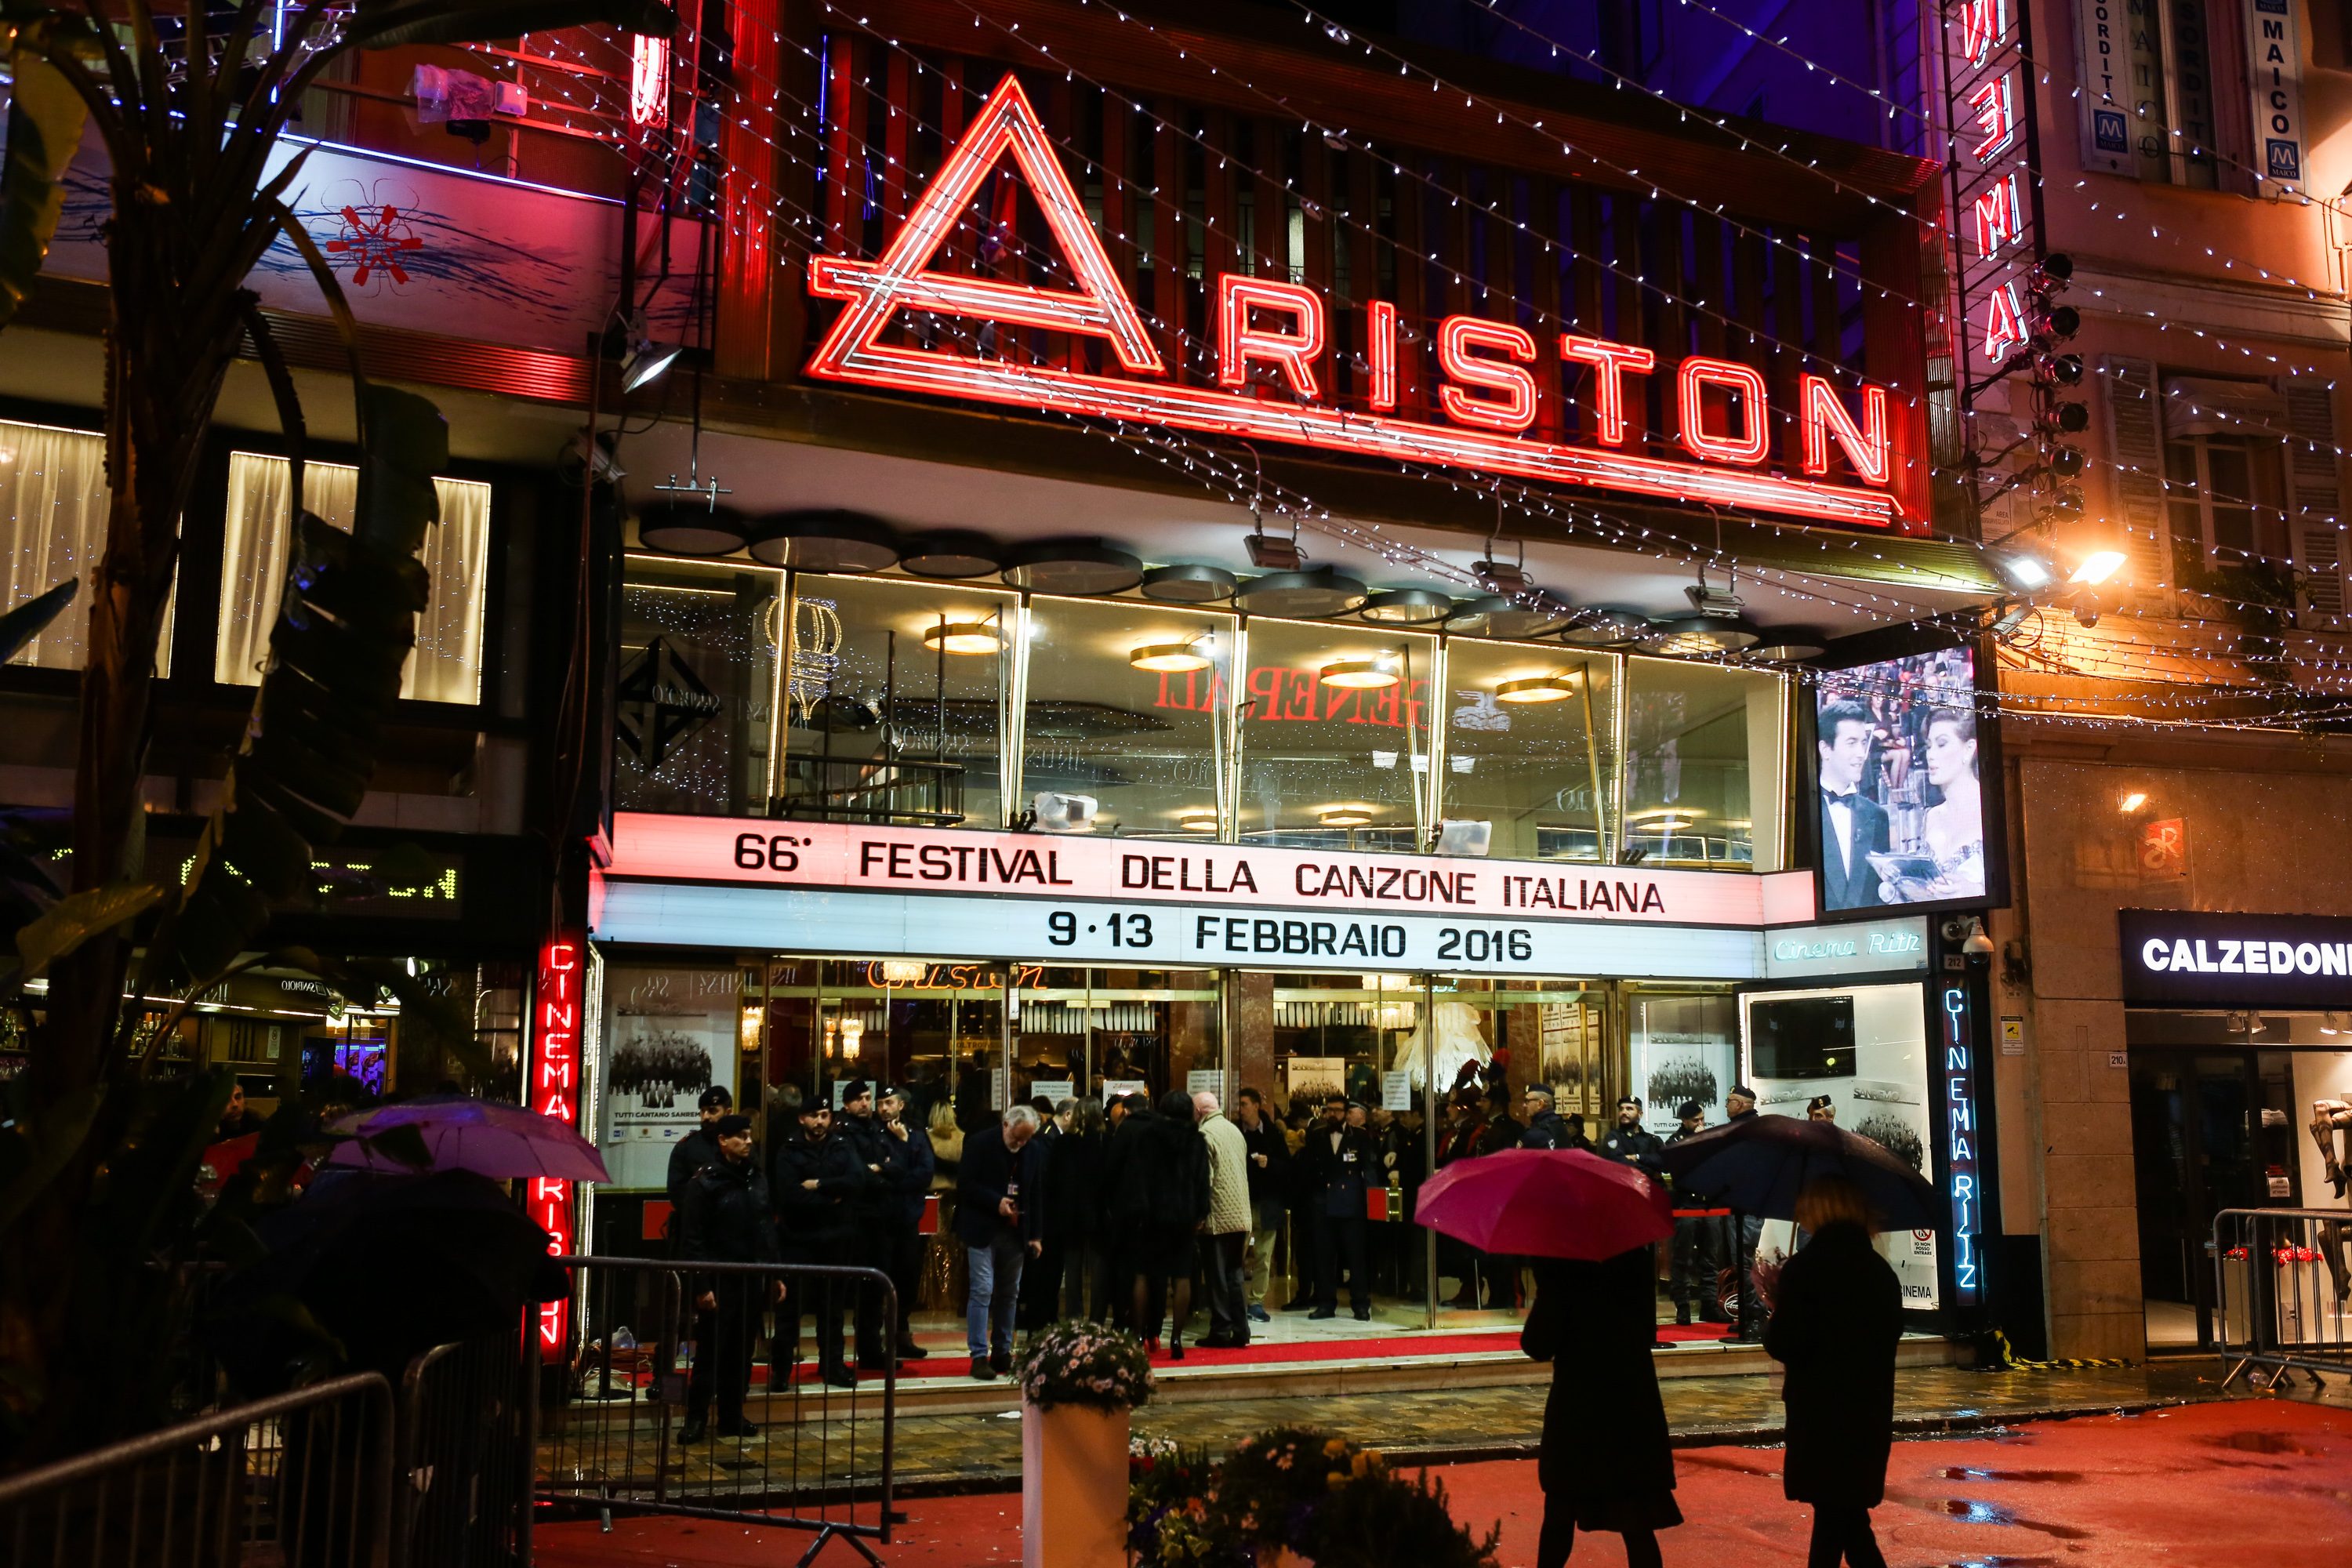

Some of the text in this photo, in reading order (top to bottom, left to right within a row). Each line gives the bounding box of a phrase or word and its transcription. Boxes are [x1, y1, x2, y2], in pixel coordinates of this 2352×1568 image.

[2096, 0, 2115, 107] ORDITÀ
[2263, 20, 2289, 134] MAICO
[2272, 169, 2296, 177] MAICO
[808, 72, 1900, 514] ARISTON
[861, 841, 1073, 884] FESTIVAL
[1122, 855, 1258, 893] DELLA
[1296, 864, 1476, 905] CANZONE
[1504, 876, 1665, 913] ITALIANA
[1196, 915, 1406, 957] FEBBRAIO
[1438, 928, 1532, 962] 2016
[1775, 940, 1857, 961] Cinema
[1947, 957, 1961, 967] 212
[544, 945, 574, 1120] CINEMA
[1946, 990, 1976, 1287] CINEMA RITZ
